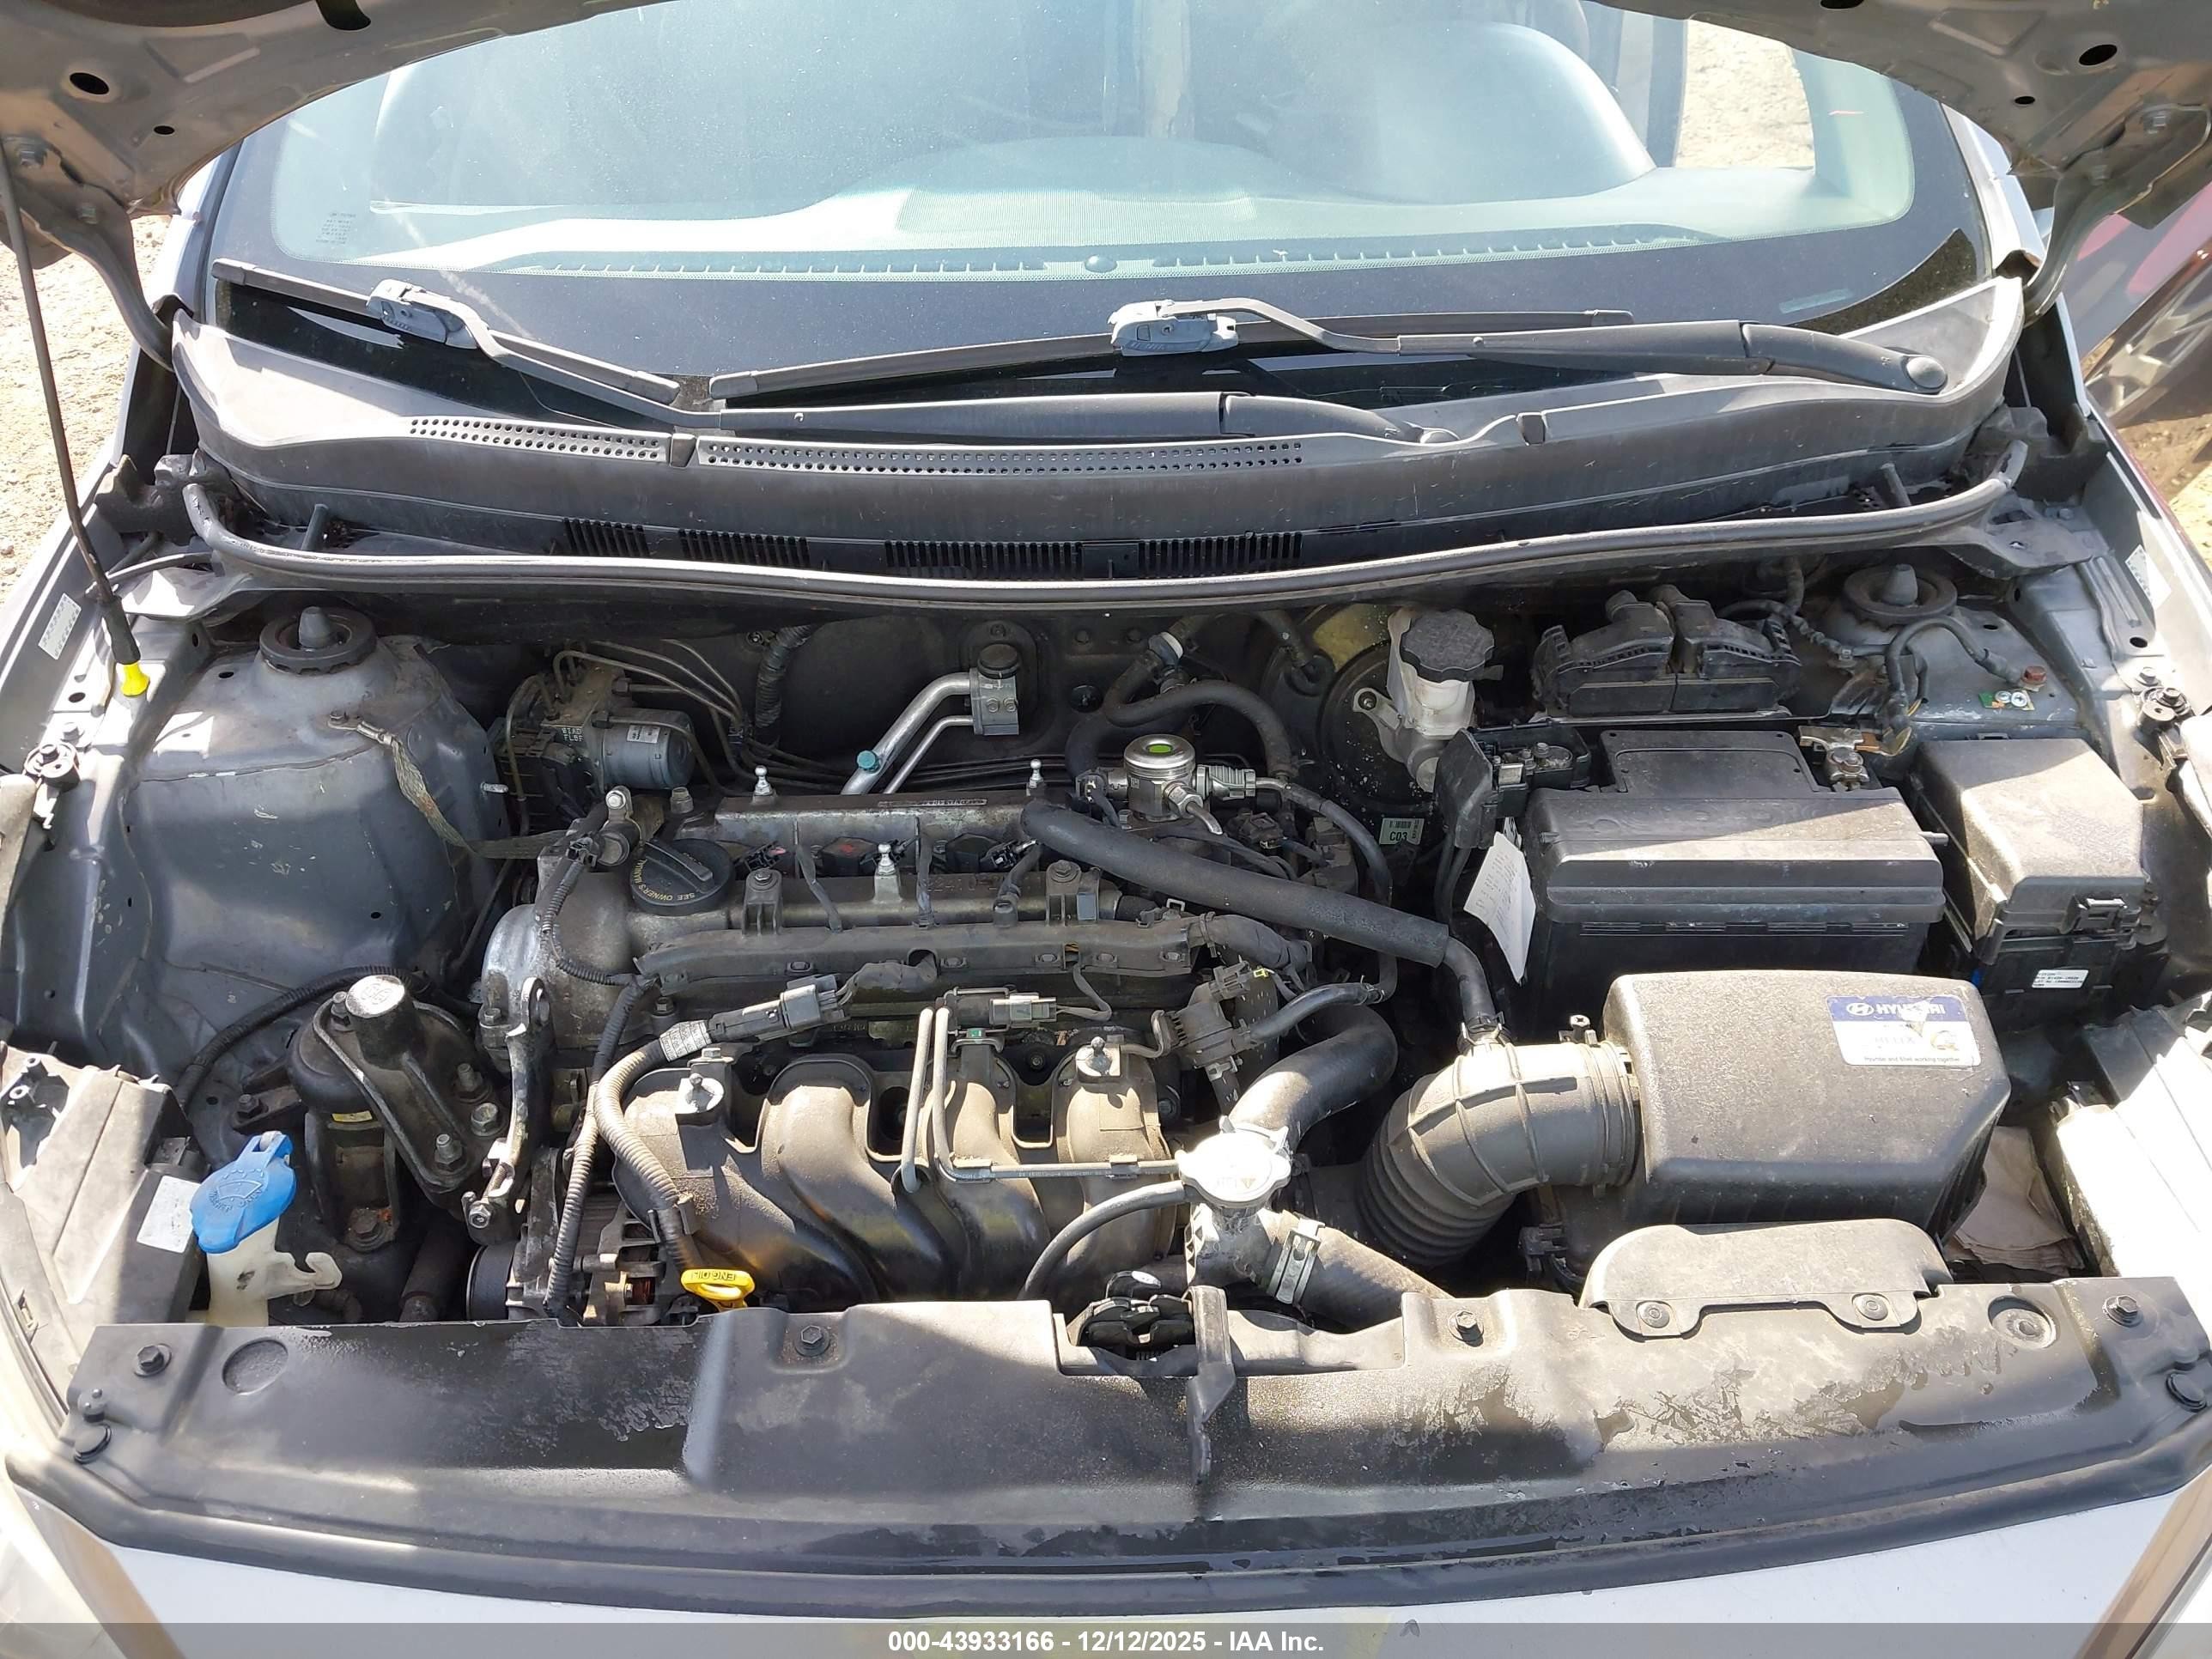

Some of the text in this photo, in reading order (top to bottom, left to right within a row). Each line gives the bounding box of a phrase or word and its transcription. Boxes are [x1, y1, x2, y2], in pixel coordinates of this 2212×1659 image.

[1389, 831, 1408, 842] C03
[677, 892, 696, 901] SEE
[712, 1271, 736, 1281] ENG
